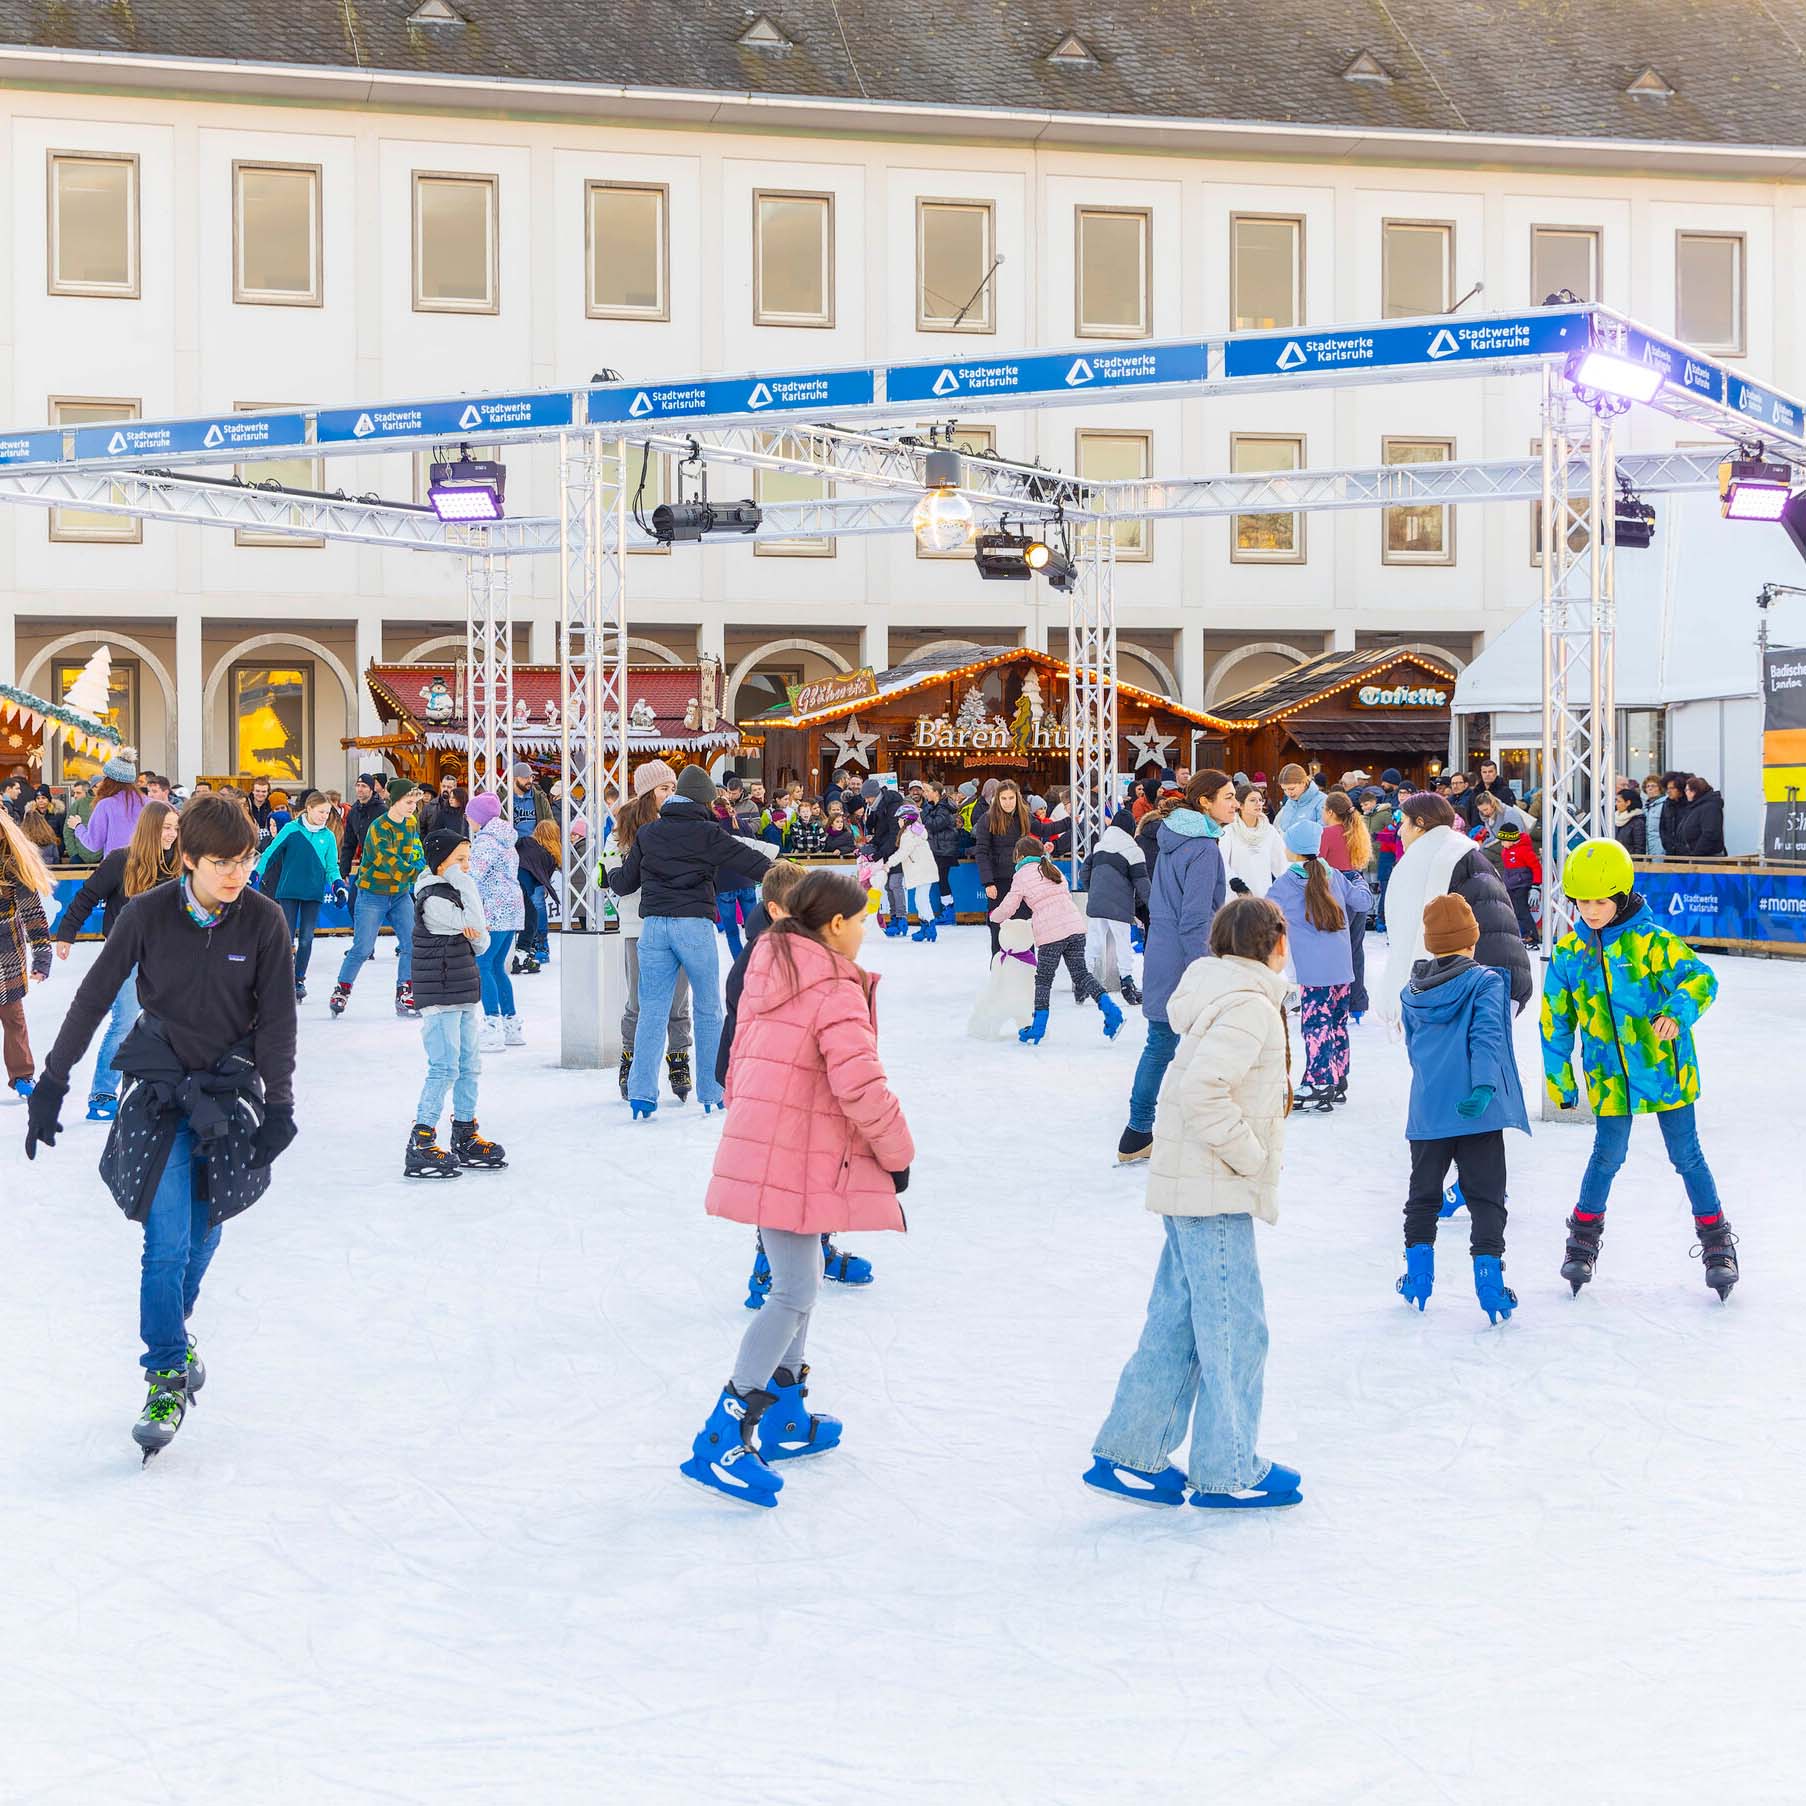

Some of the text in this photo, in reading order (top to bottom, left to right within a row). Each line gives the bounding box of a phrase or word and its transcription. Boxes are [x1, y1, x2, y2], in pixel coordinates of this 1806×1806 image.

[1459, 325, 1530, 340] Stadtwerke
[1306, 337, 1374, 351] Stadtwerke
[1471, 336, 1530, 350] Karlsruhe
[1317, 348, 1374, 362] Karlsruhe
[1094, 355, 1156, 368] Stadtwerke
[959, 365, 1018, 379] Stadtwerke
[1104, 365, 1156, 378] Karlsruhe
[772, 380, 828, 392] Stadtwerke
[969, 375, 1018, 388] Karlsruhe
[652, 389, 706, 401] Stadtwerke
[782, 390, 828, 401] Karlsruhe
[481, 402, 531, 414] Stadtwerke
[661, 399, 706, 410] Karlsruhe
[374, 411, 422, 422] Stadtwerke
[489, 411, 531, 423] Karlsruhe
[223, 422, 269, 434] Stadtwerke
[382, 420, 422, 431] Karlsruhe
[126, 430, 171, 441] Stadtwerke
[231, 430, 269, 442] Karlsruhe
[134, 438, 171, 448] Karlsruhe
[916, 720, 1008, 749] Bären
